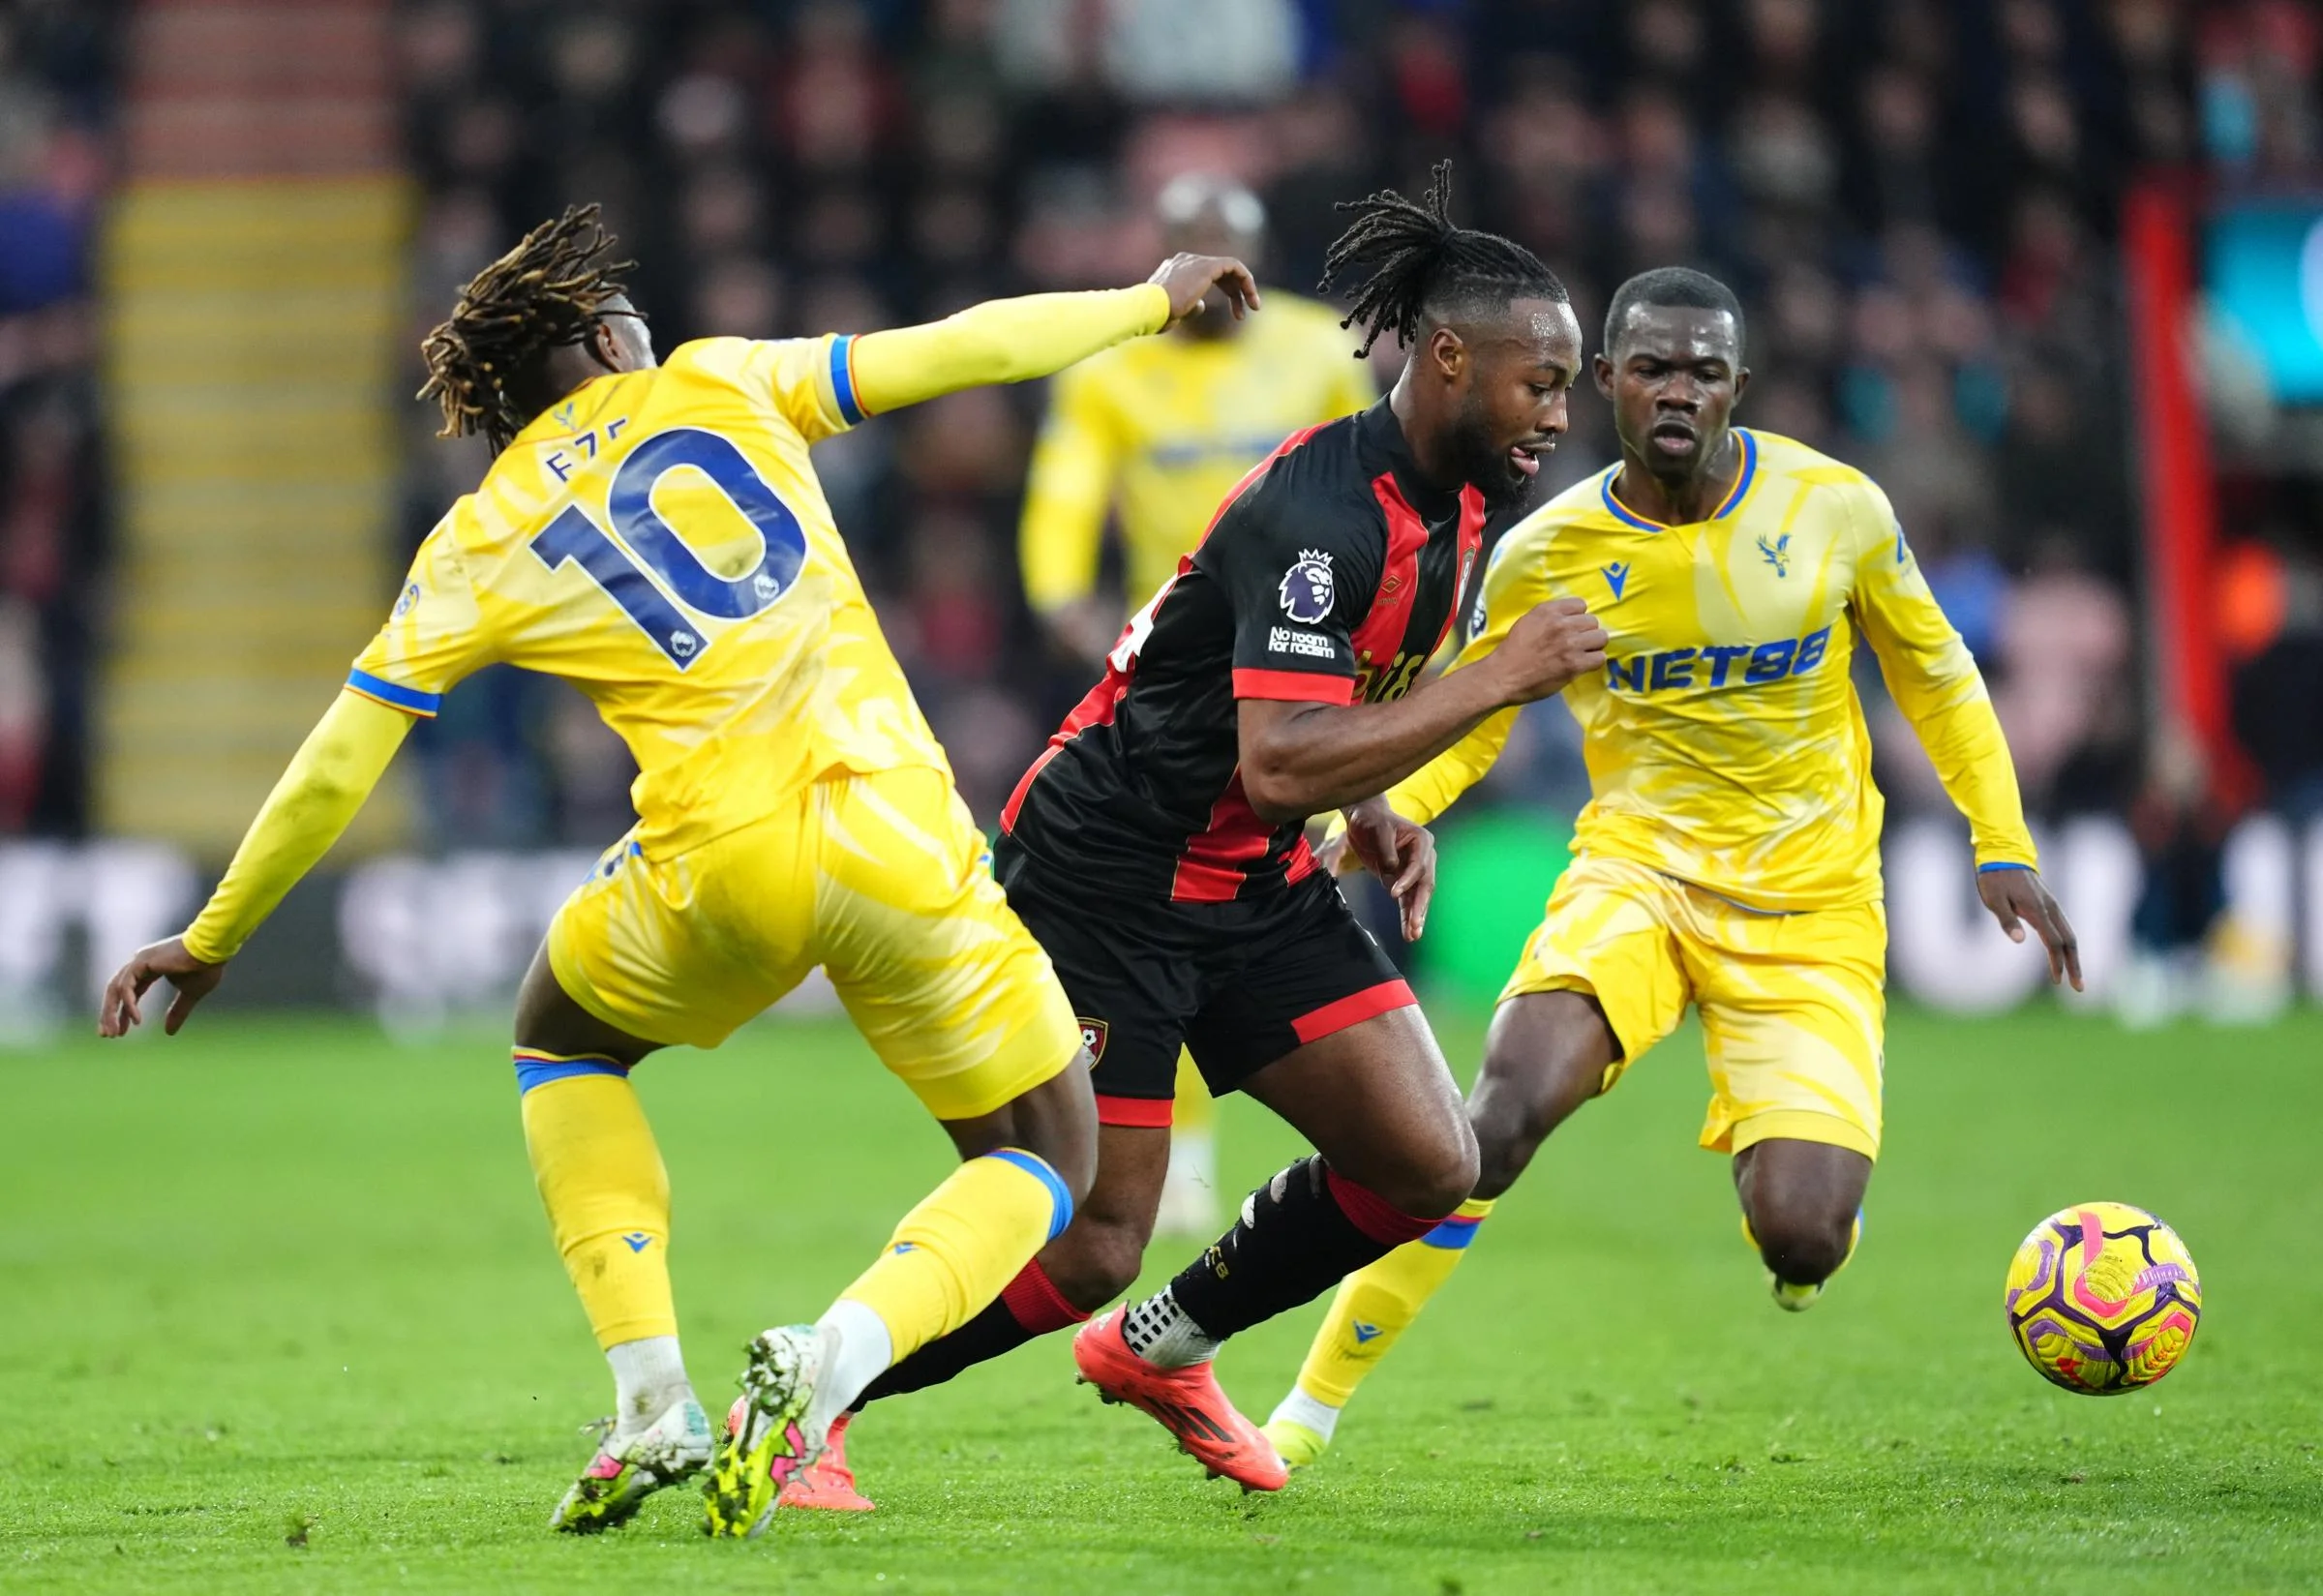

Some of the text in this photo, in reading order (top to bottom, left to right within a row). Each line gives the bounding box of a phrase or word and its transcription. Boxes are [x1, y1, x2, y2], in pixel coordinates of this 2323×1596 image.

[528, 425, 810, 674] 10
[1268, 639, 1335, 659] for racism
[1269, 626, 1329, 647] No room
[1606, 624, 1832, 694] NET88
